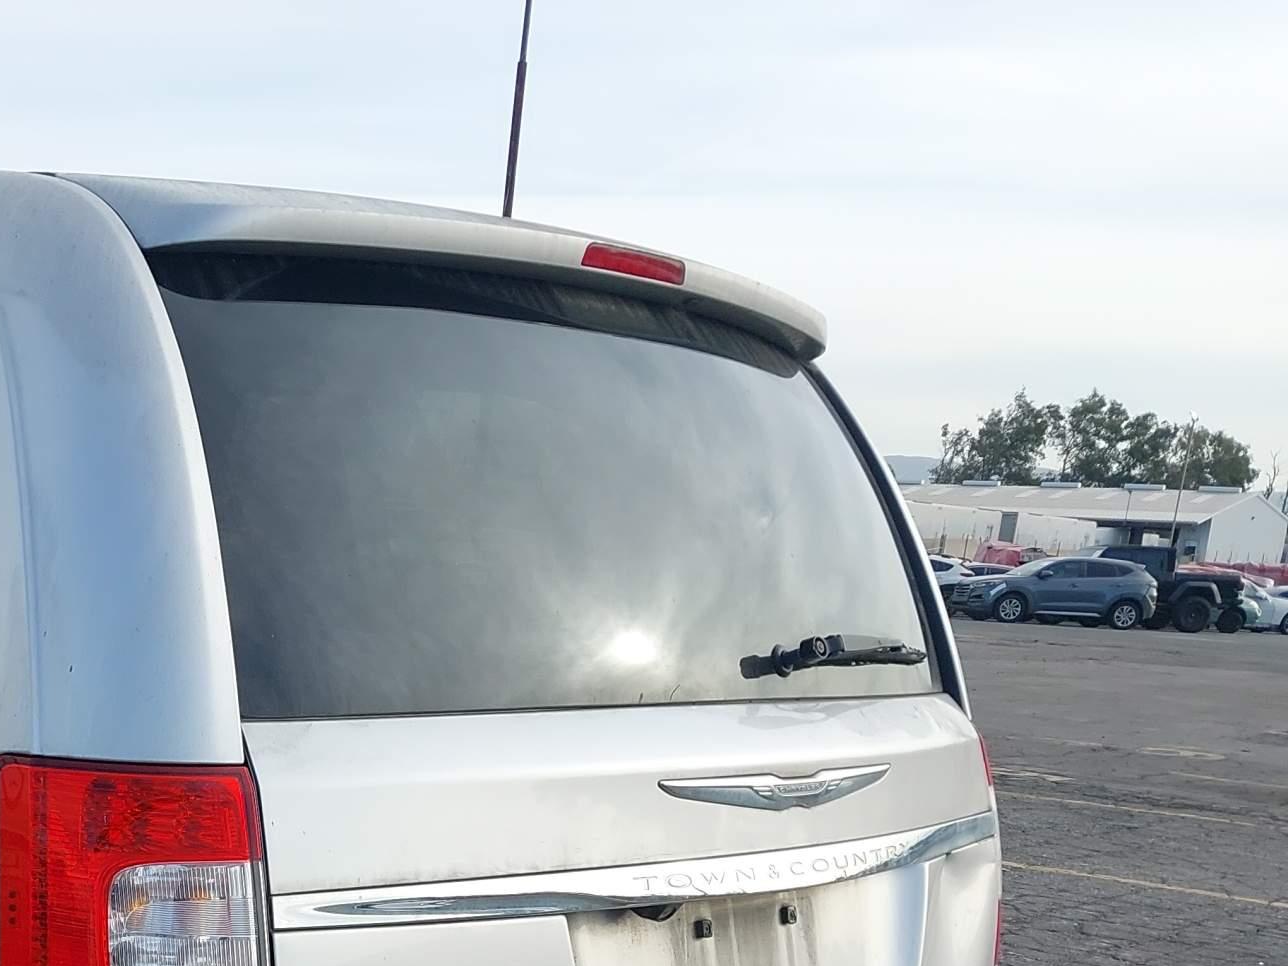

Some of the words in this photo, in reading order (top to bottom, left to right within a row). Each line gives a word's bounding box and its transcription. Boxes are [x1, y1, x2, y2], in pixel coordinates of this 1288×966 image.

[632, 867, 757, 891] TOWN
[768, 863, 781, 881] &
[789, 841, 910, 877] COUNTRY
